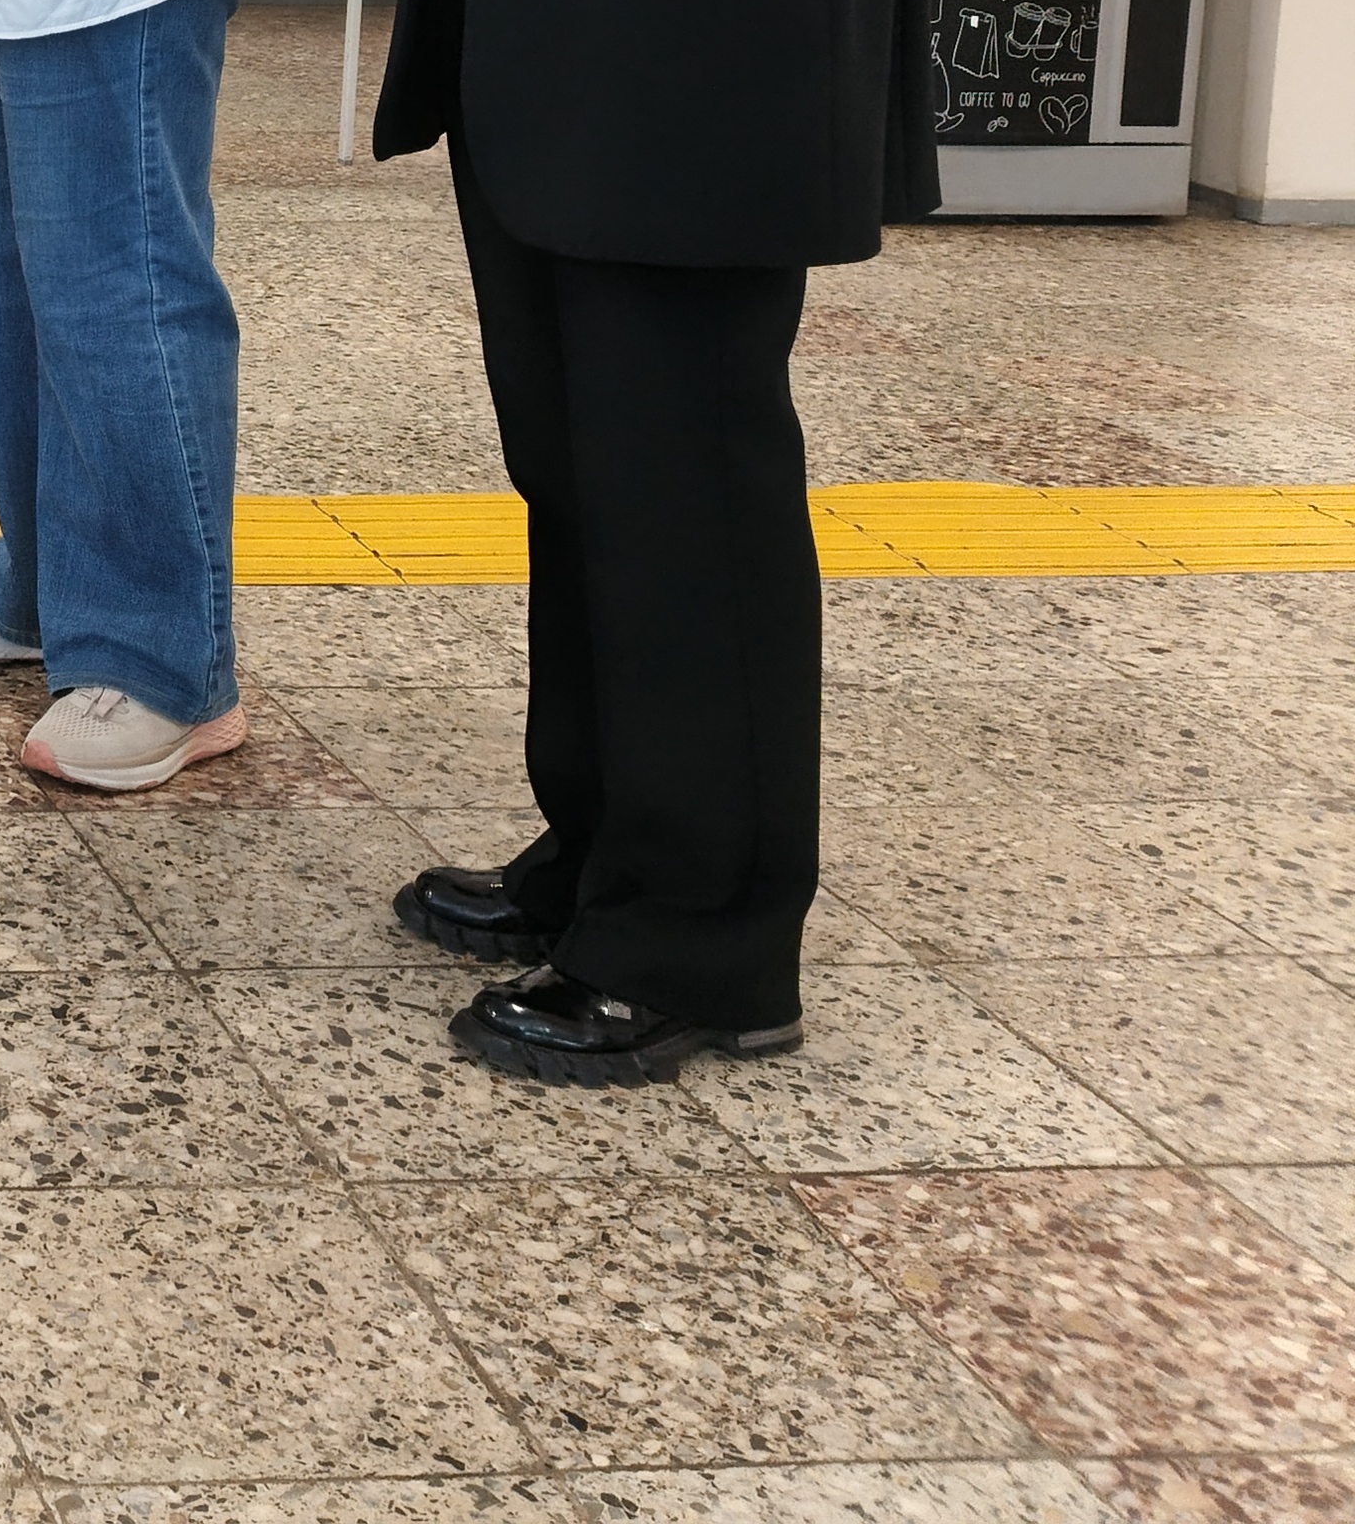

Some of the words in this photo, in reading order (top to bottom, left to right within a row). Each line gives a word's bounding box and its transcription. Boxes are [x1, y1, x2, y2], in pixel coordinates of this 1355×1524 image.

[1031, 66, 1087, 86] Cappuccino
[959, 92, 995, 108] COFFEE
[1001, 92, 1014, 107] TO
[1018, 93, 1031, 108] GO
